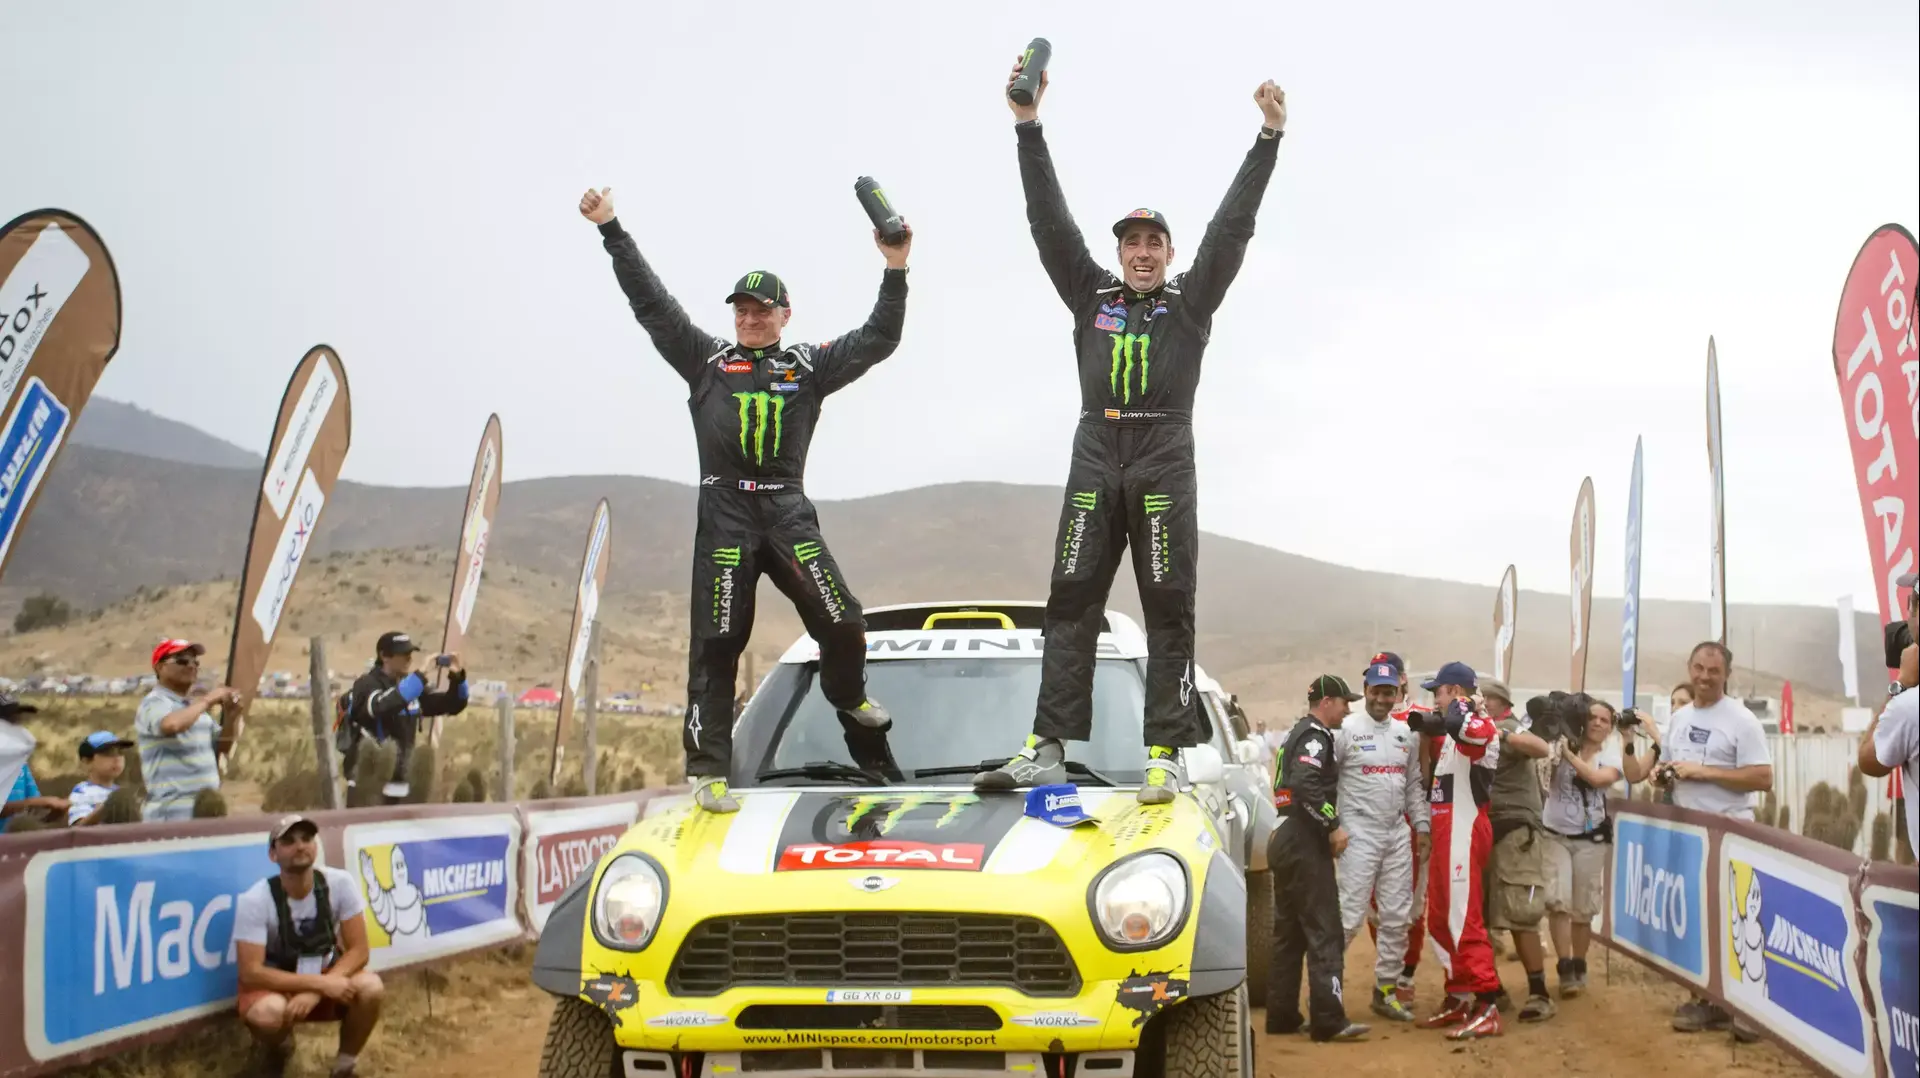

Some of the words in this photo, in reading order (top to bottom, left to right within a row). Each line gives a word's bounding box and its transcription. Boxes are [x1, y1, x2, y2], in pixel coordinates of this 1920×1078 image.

[0, 281, 49, 377] DOX
[2, 356, 25, 393] Swiss
[0, 398, 51, 518] CHELIN
[1847, 306, 1914, 622] TOTAL
[1061, 519, 1075, 564] ENERGY
[1065, 511, 1087, 575] MONSTER
[1150, 515, 1164, 582] MONSTER
[1162, 525, 1170, 572] ENERGY
[712, 577, 721, 624] ENERGY
[719, 567, 733, 634] MONSTER
[808, 560, 842, 624] MONSTER
[823, 568, 846, 611] ENERGY
[423, 860, 504, 897] MICHELIN
[791, 846, 974, 864] TOTAL
[1625, 841, 1687, 940] Macro
[94, 880, 237, 996] Mac
[1767, 913, 1846, 989] MICHELIN
[842, 990, 860, 1001] GG
[864, 990, 881, 1001] XR
[885, 990, 902, 1001] 60
[665, 1015, 707, 1027] WORKS
[743, 1033, 997, 1047] www.MINIspace.com/motorsport
[1033, 1016, 1079, 1027] WORKS
